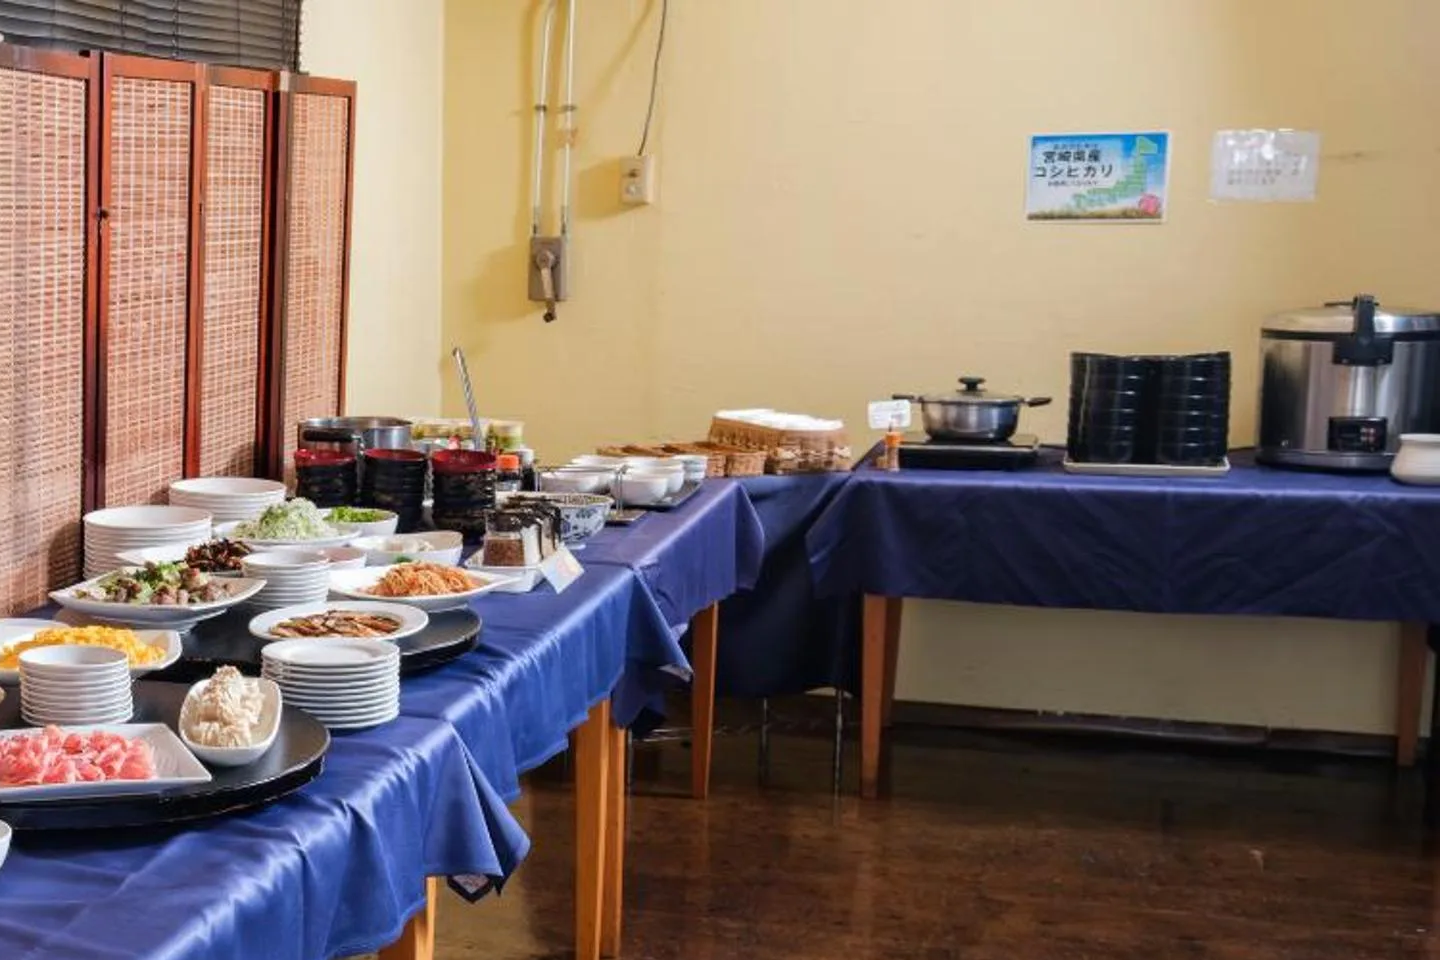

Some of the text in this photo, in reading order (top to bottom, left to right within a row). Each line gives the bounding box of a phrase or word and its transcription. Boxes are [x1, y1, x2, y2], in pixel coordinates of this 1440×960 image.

[1034, 164, 1113, 178] コシヒカリ
